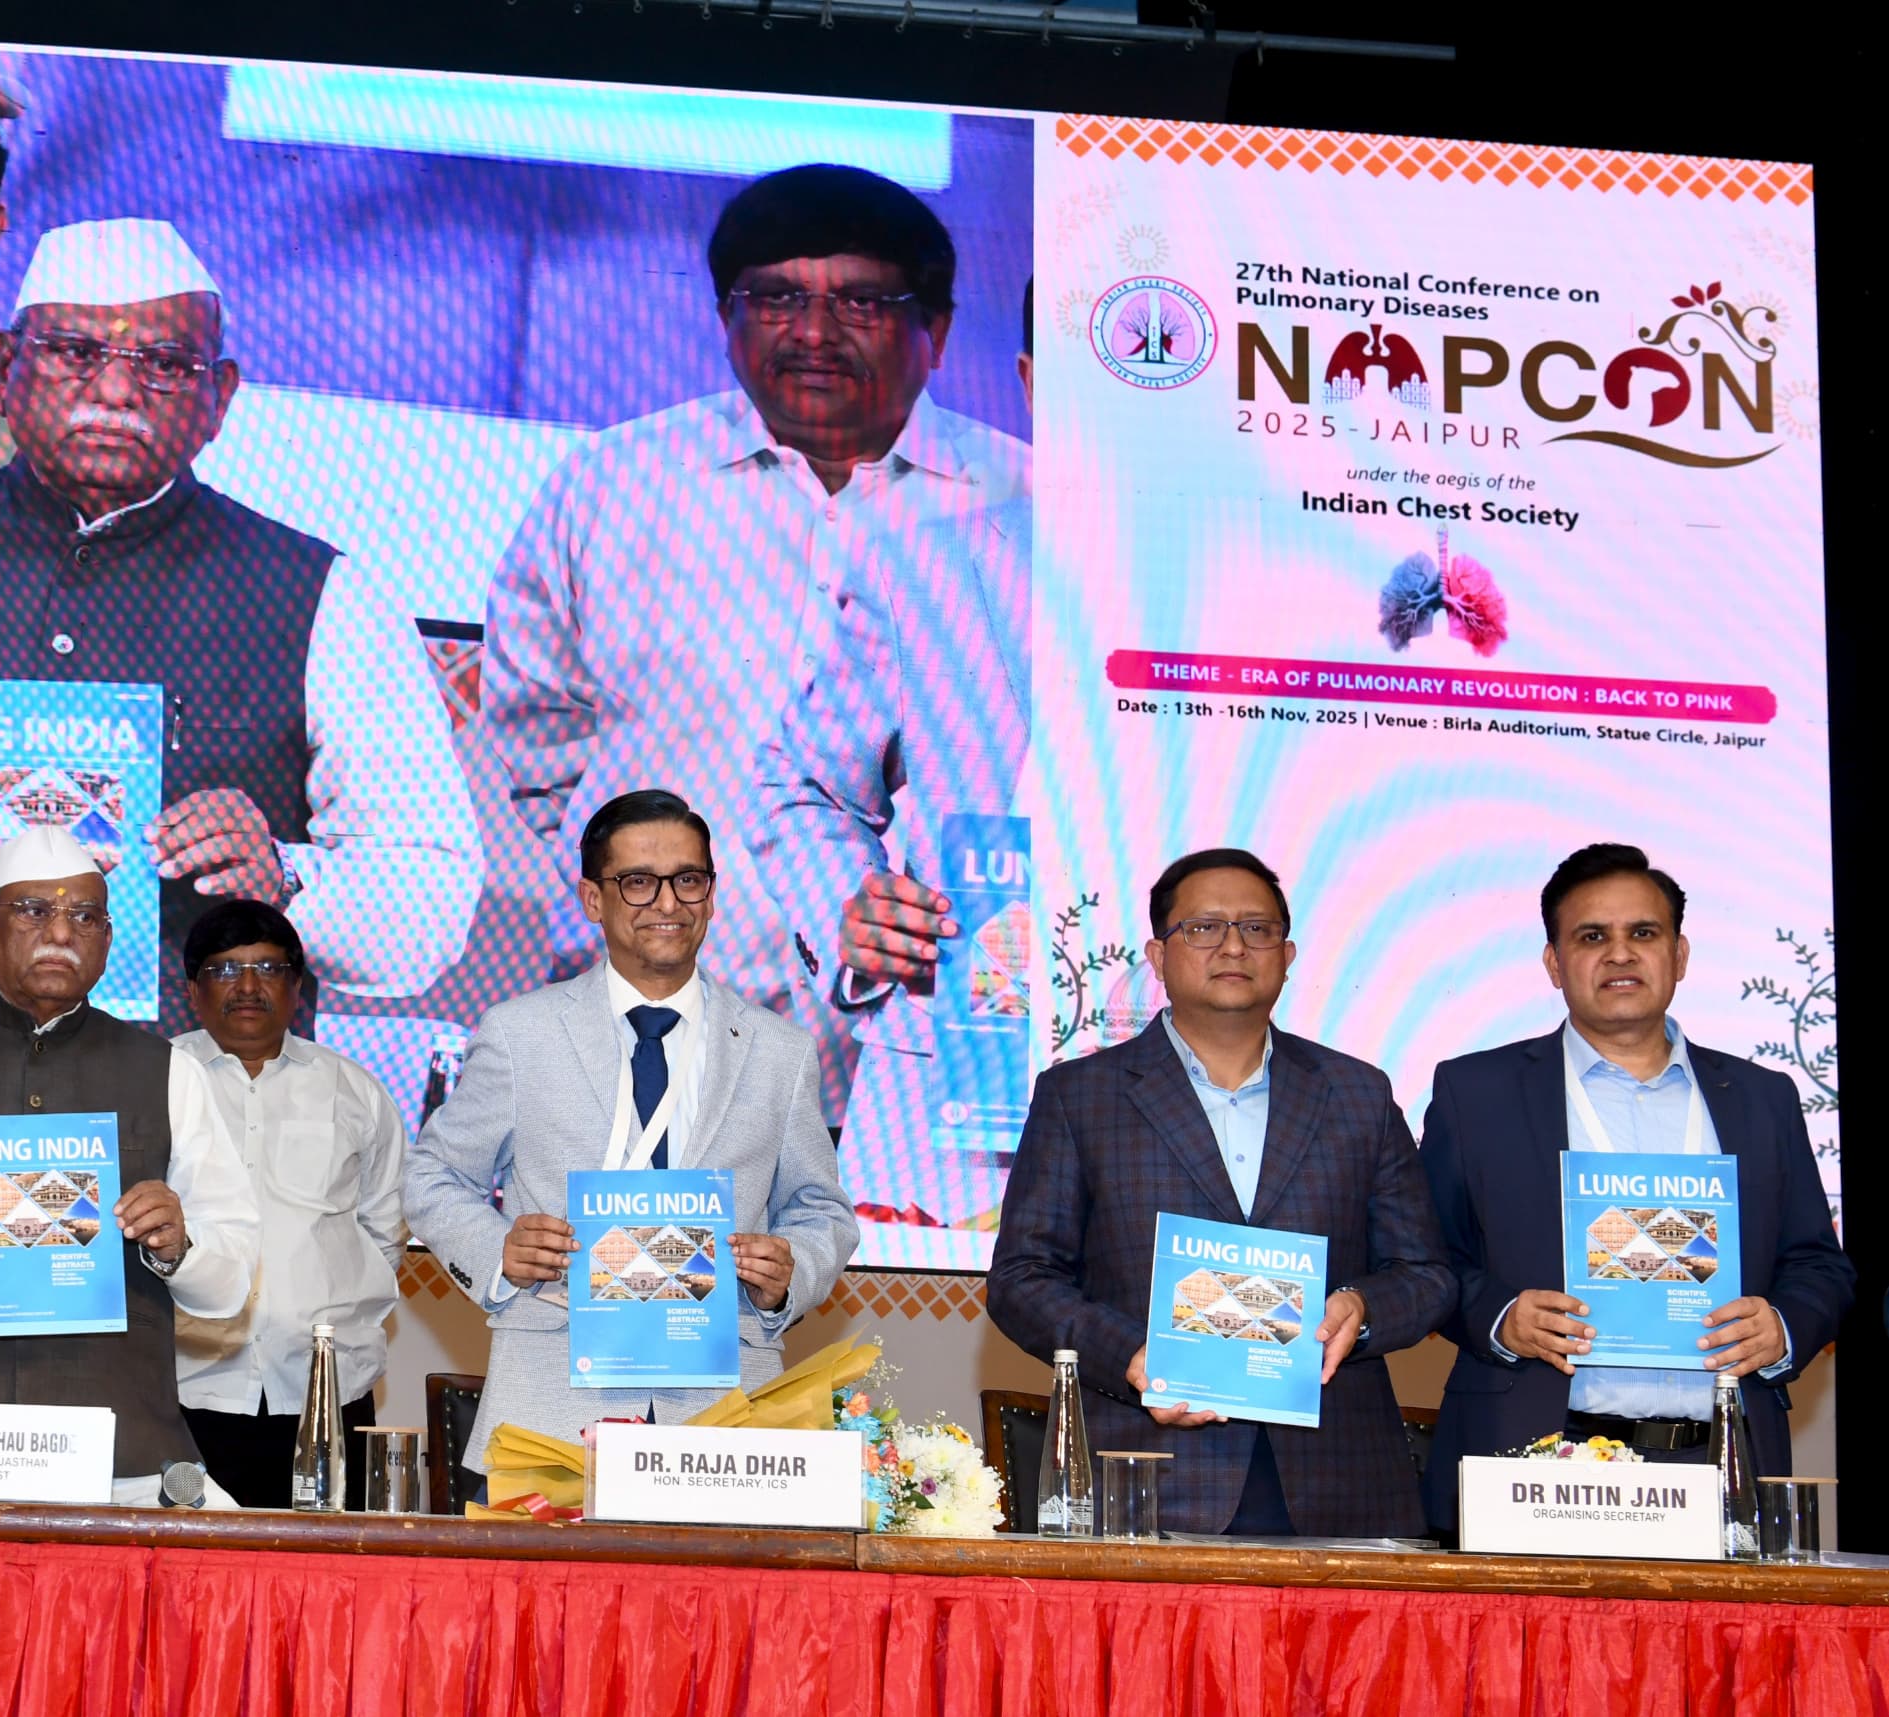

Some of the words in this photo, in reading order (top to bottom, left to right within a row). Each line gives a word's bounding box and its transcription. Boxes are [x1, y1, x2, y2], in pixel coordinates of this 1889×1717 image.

[1236, 263, 1292, 283] 27th
[1302, 267, 1409, 291] National
[1418, 274, 1560, 300] Conference
[1569, 287, 1600, 302] on
[1237, 287, 1374, 317] Pulmonary
[1383, 297, 1489, 320] Diseases
[1347, 465, 1398, 483] under
[1404, 469, 1430, 485] the
[1437, 473, 1480, 489] aegis
[1486, 474, 1508, 491] of
[1509, 476, 1535, 491] the
[1302, 491, 1387, 515] Indian
[1397, 497, 1472, 520] Chest
[1482, 502, 1579, 532] Society
[1151, 663, 1220, 681] THEME
[1241, 668, 1278, 685] ERA
[1285, 670, 1310, 686] OF
[1317, 671, 1445, 694] PULMONARY
[1452, 681, 1577, 702] REVOLUTION
[1595, 688, 1648, 706] BACK
[1653, 692, 1679, 707] TO
[1686, 693, 1733, 711] PINK
[23, 716, 141, 753] INDIA
[1118, 699, 1158, 713] Date
[1174, 702, 1213, 716] 13th
[1271, 707, 1310, 723] Nov,
[1316, 710, 1358, 725] 2025
[1375, 713, 1428, 728] Venue
[1443, 717, 1481, 732] Birla
[1487, 719, 1591, 740] Auditorium,
[1597, 726, 1651, 741] Statue
[1657, 729, 1708, 746] Circle,
[1714, 732, 1766, 750] Jaipur
[38, 1135, 107, 1162] INDIA
[1579, 1174, 1648, 1197] LUNG
[1654, 1176, 1725, 1199] INDIA
[583, 1193, 649, 1216] LUNG
[655, 1193, 723, 1215] INDIA
[1172, 1235, 1239, 1264] LUNG
[1245, 1246, 1314, 1273] INDIA
[635, 1451, 671, 1473] DR.
[681, 1453, 737, 1475] RAJA
[746, 1455, 806, 1477] DHAR
[768, 1479, 788, 1489] ICS
[1512, 1483, 1544, 1503] DR
[1555, 1484, 1621, 1506] NITIN
[1631, 1487, 1687, 1508] JAIN
[1533, 1508, 1601, 1521] ORGANISING
[1603, 1511, 1665, 1523] SECRETARY
